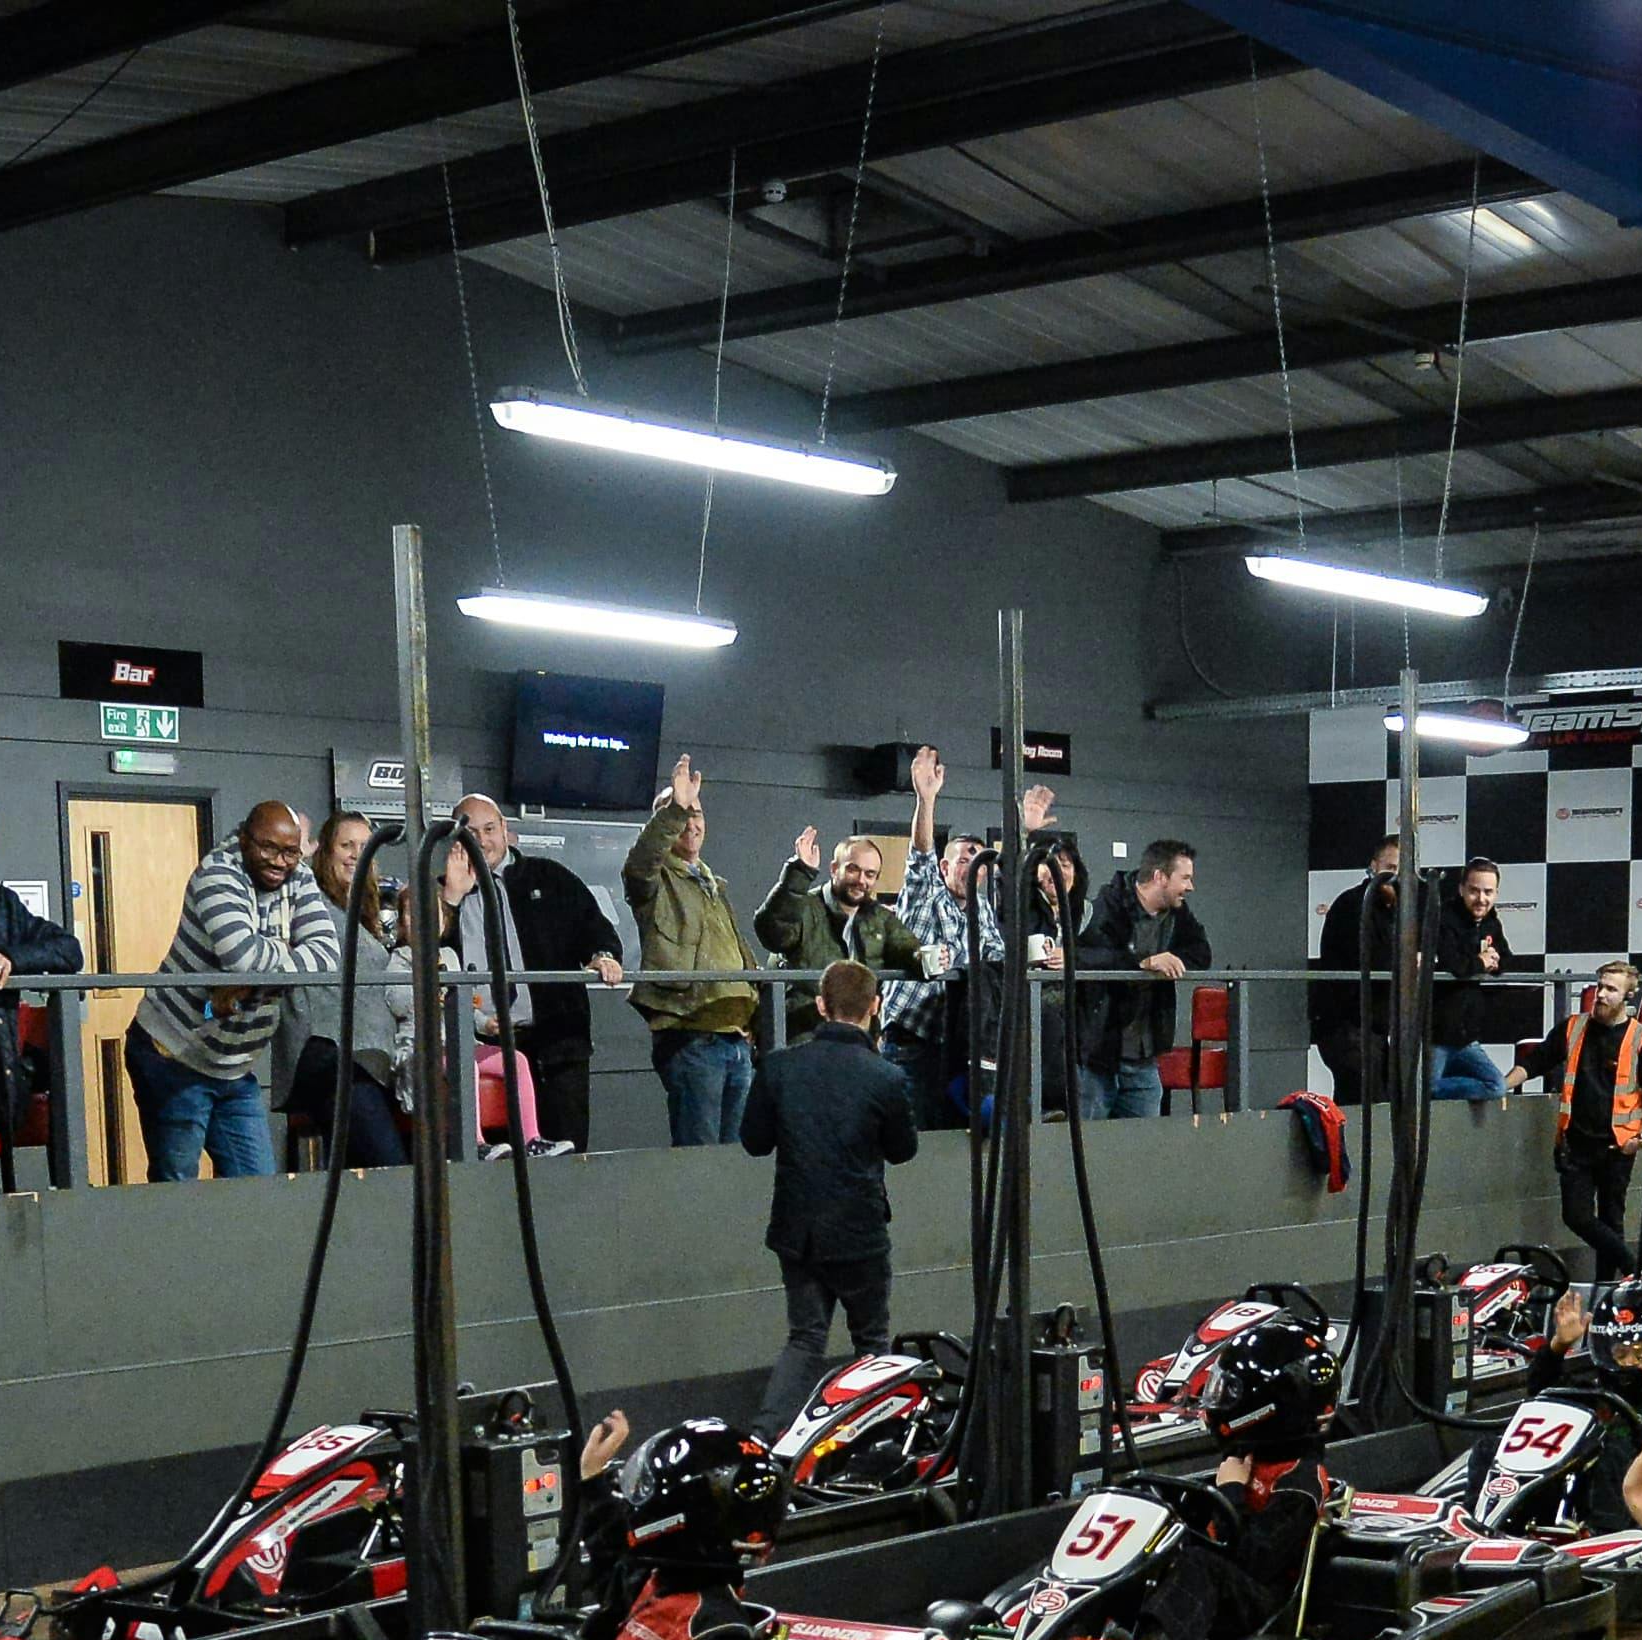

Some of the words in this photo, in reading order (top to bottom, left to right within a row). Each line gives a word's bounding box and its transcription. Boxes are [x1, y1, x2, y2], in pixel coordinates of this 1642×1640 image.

[113, 662, 155, 684] Bar
[106, 708, 128, 721] Fire
[107, 723, 127, 734] exit
[543, 732, 577, 748] Waiting
[577, 734, 591, 747] for
[591, 736, 609, 749] first
[1038, 745, 1063, 759] Room
[1226, 1307, 1261, 1317] 18
[860, 1361, 902, 1372] 17
[1503, 1417, 1575, 1460] 54
[1064, 1512, 1137, 1561] 51
